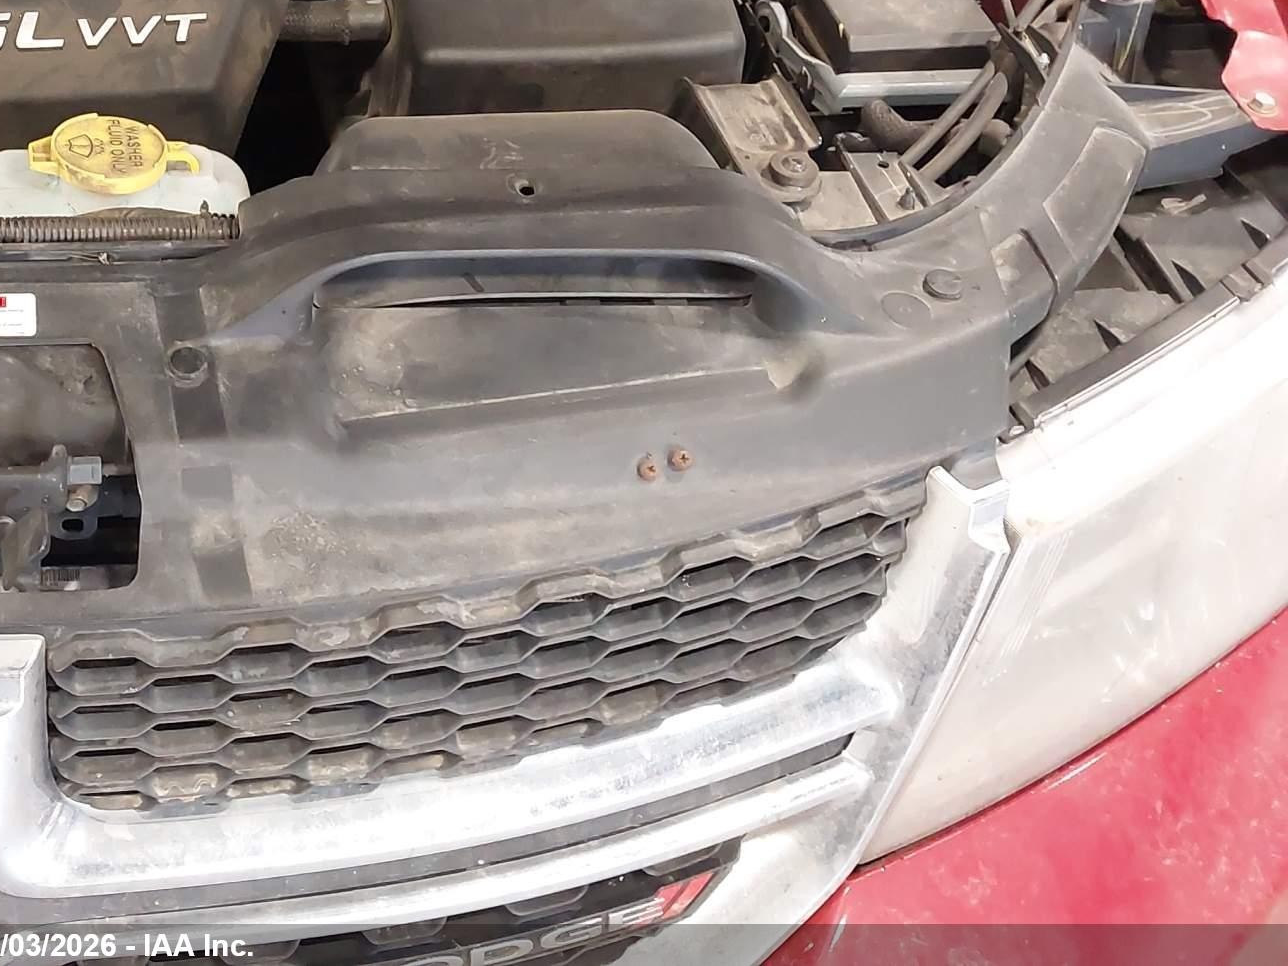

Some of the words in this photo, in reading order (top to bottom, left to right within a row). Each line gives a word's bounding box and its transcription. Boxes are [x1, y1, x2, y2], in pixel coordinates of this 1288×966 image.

[77, 12, 208, 49] VVT
[106, 119, 123, 146] FLUID
[124, 125, 143, 167] WASHER
[110, 148, 128, 174] ONLY
